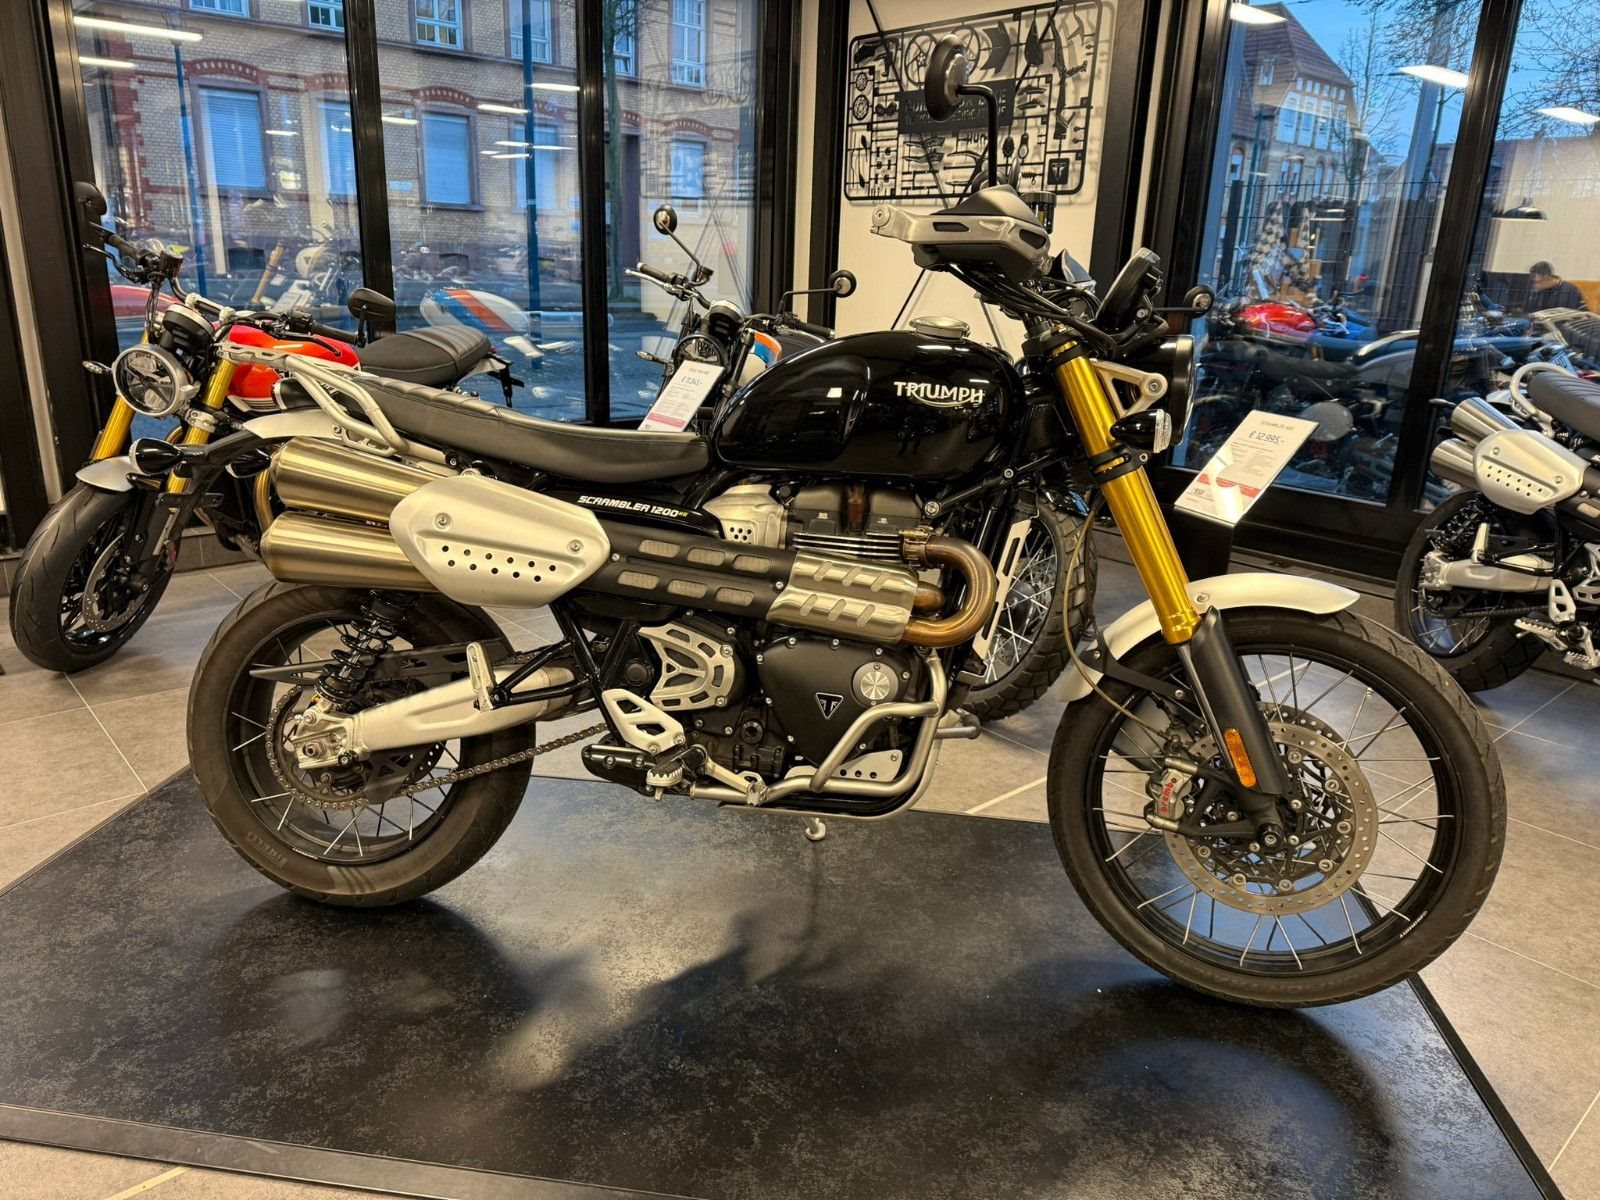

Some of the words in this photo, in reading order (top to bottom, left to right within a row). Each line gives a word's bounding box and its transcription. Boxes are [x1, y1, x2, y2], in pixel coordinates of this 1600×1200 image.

[893, 381, 986, 405] TRIUMPH
[577, 495, 651, 512] SCRAMBLER
[651, 506, 679, 518] 1200
[1159, 777, 1178, 814] brembo
